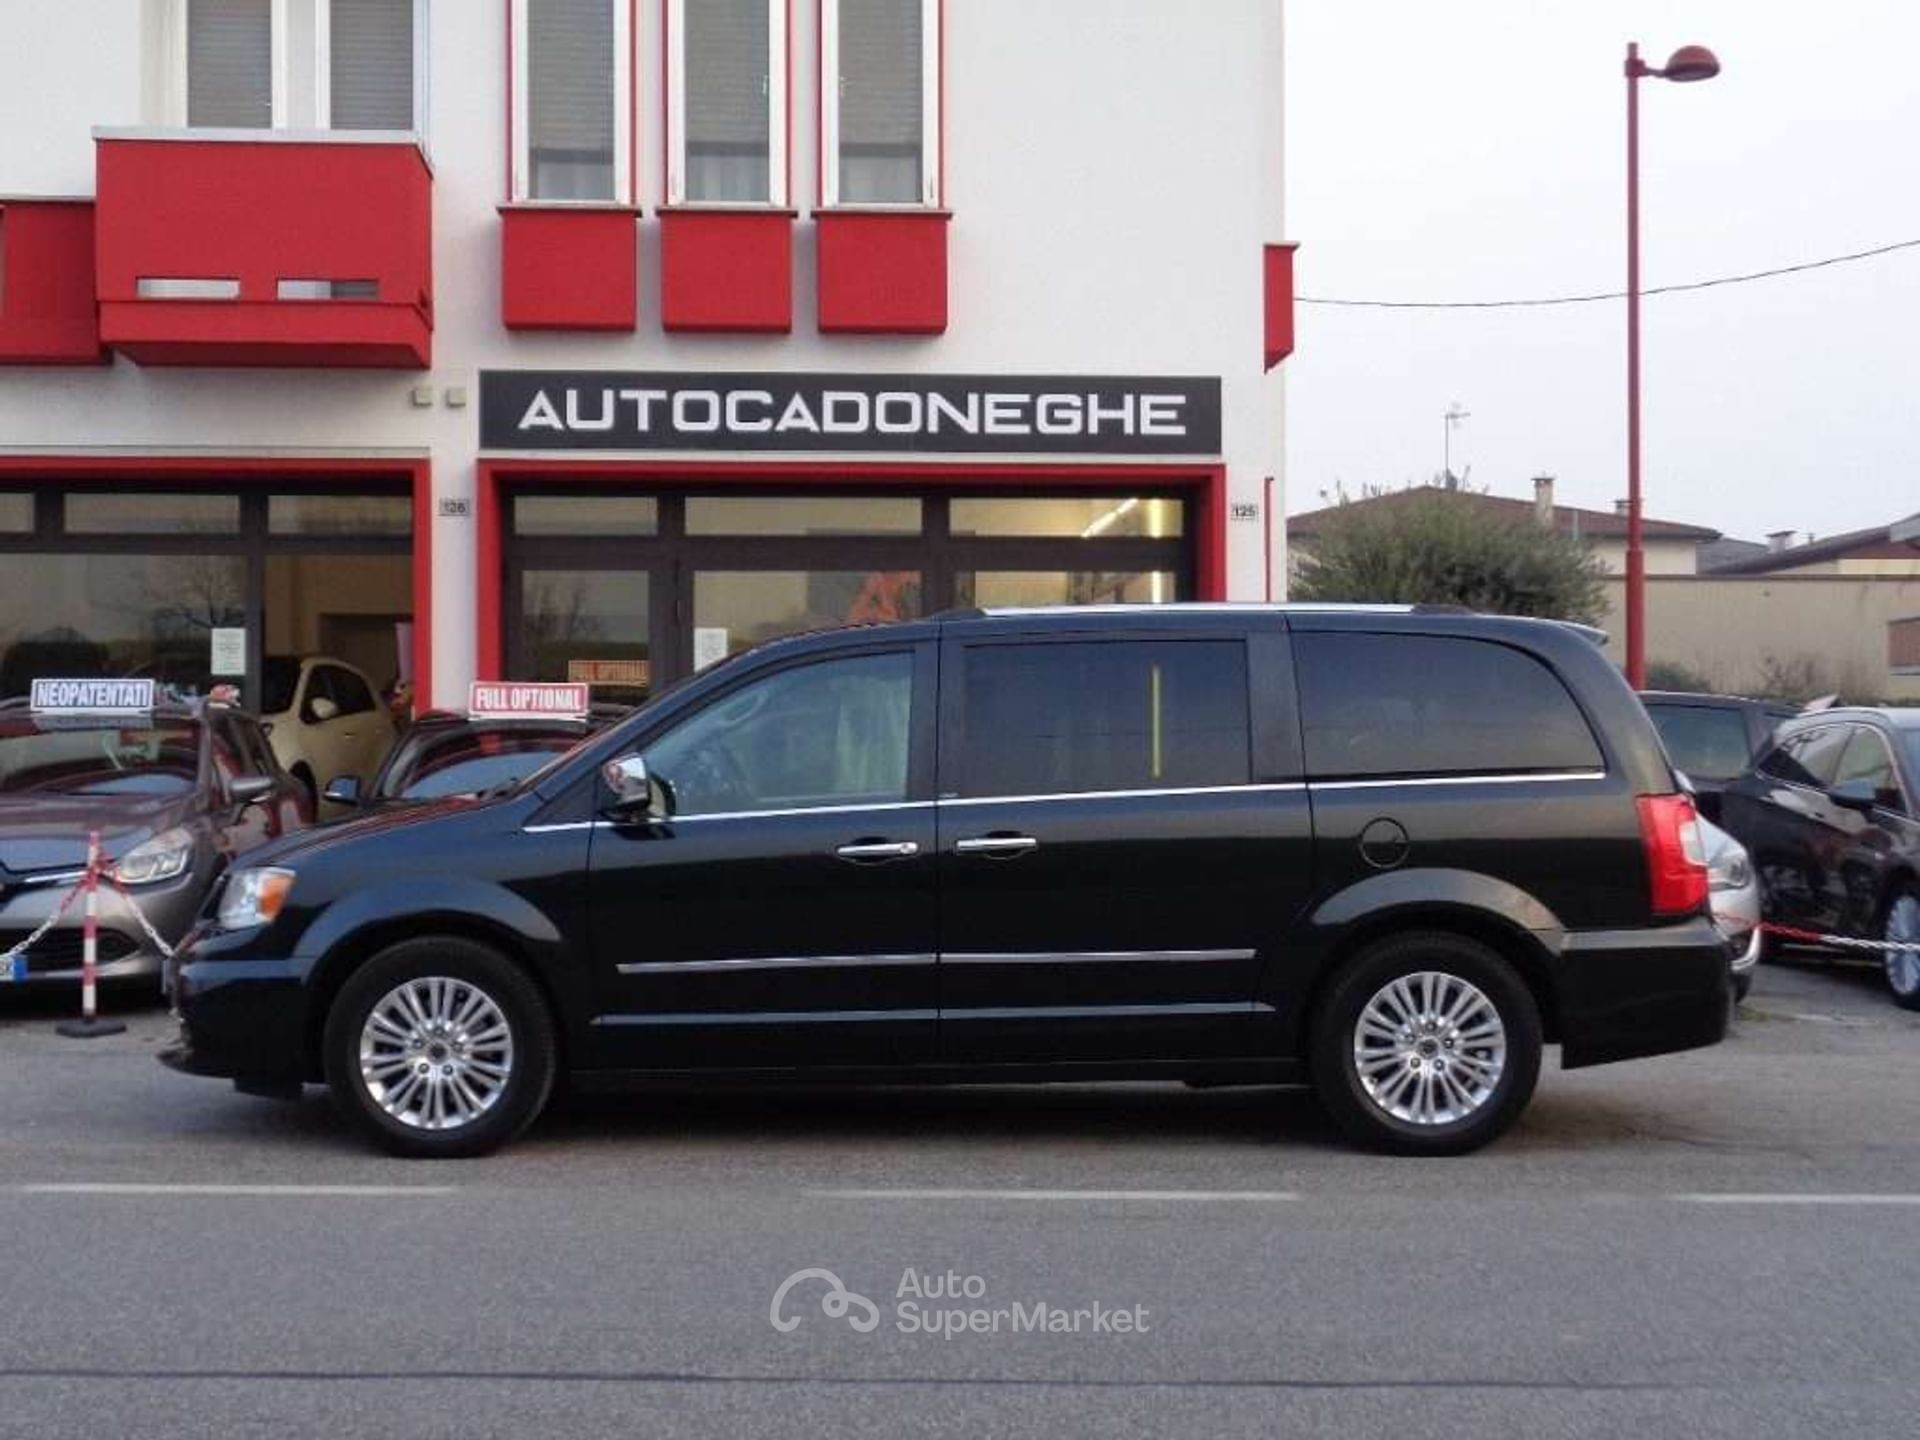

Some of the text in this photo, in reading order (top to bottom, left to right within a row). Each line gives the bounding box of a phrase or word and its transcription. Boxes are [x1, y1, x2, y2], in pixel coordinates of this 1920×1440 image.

[517, 389, 1187, 435] AUTOCADONEGHE
[36, 681, 148, 707] NEOPATENTATI
[475, 686, 581, 711] FULL OPTIONAL
